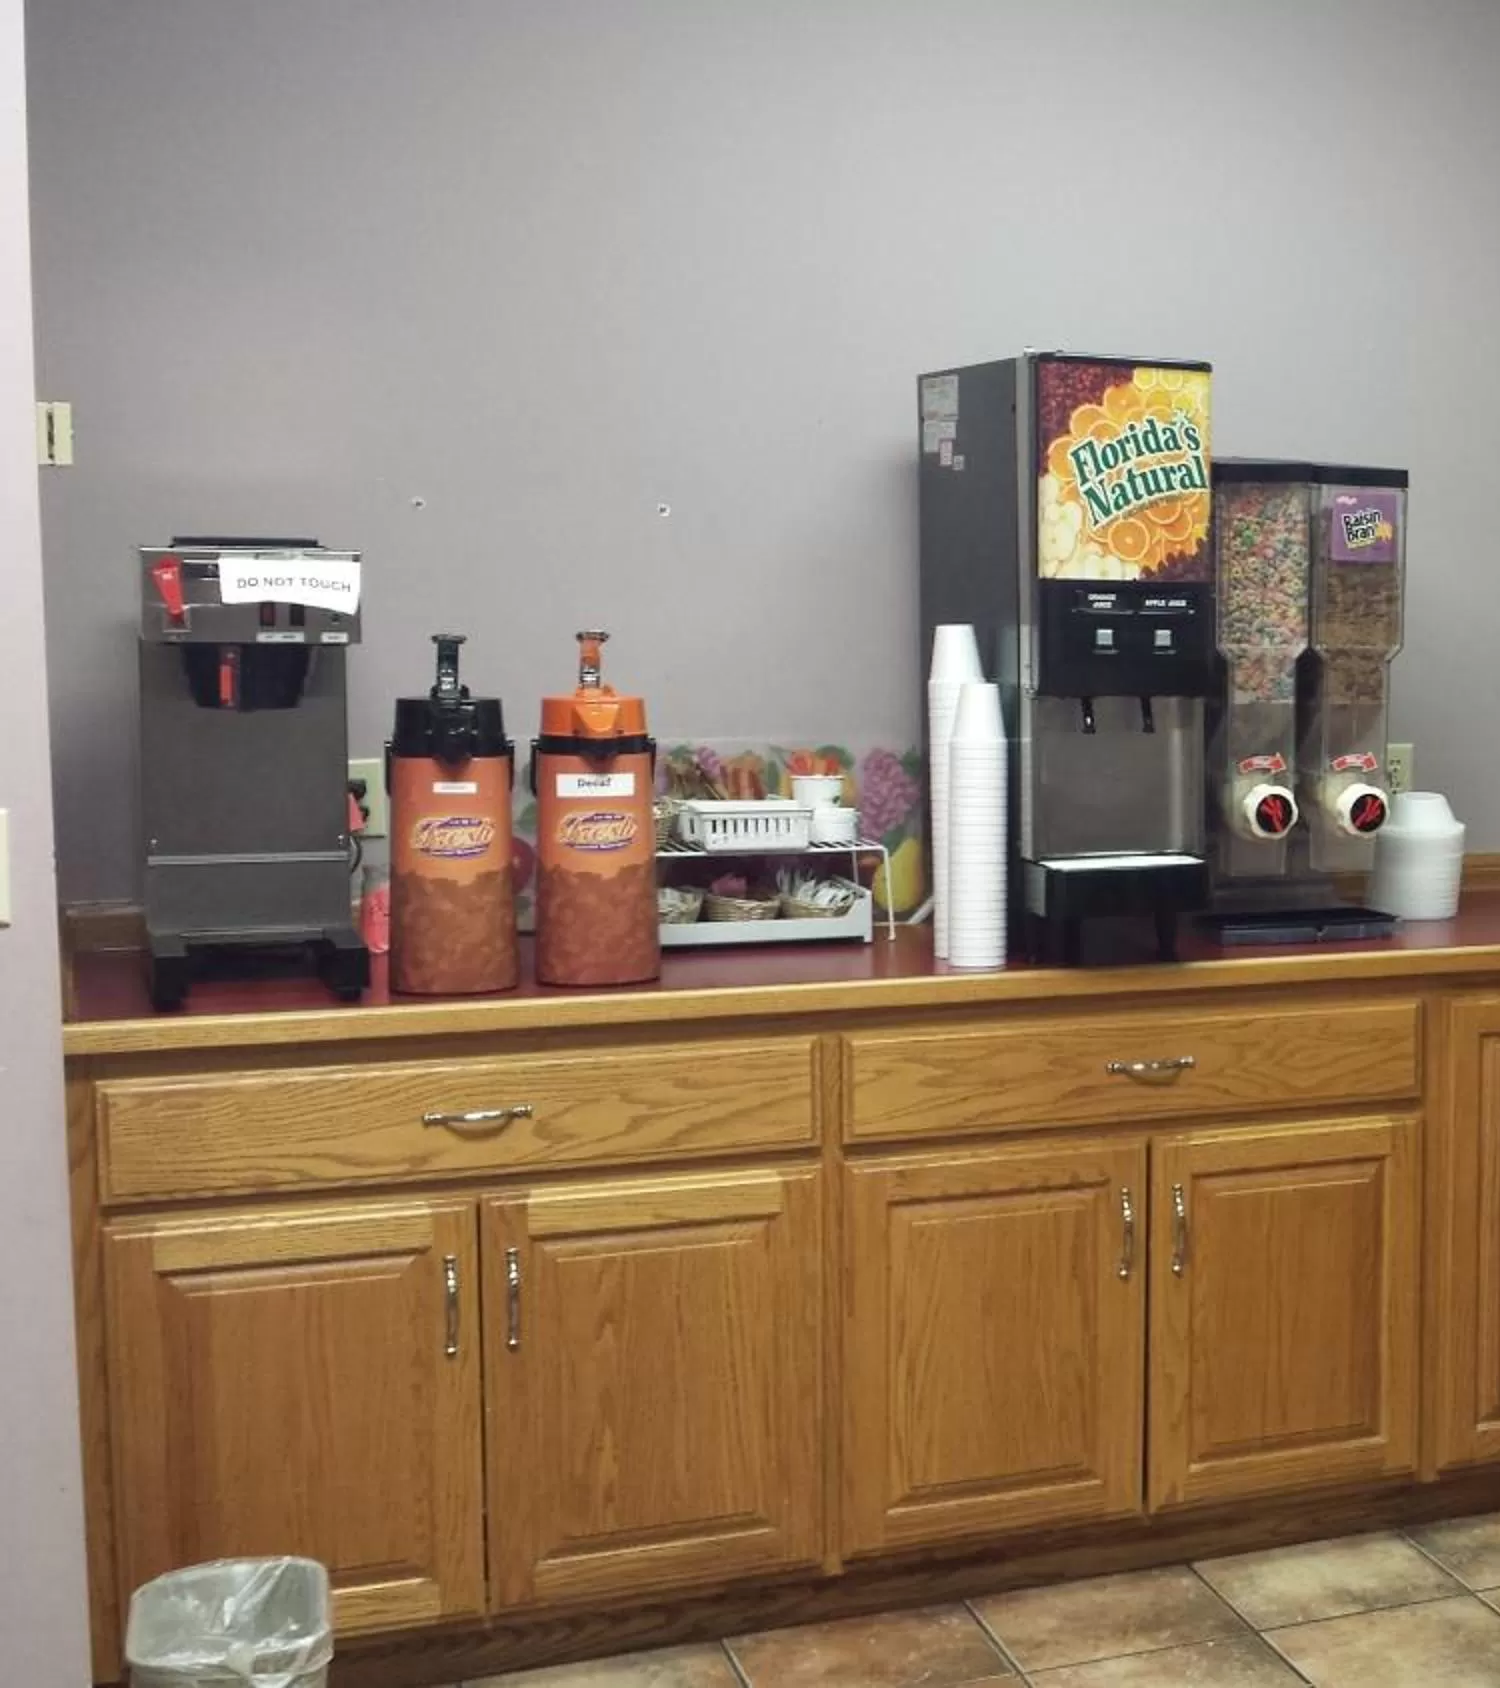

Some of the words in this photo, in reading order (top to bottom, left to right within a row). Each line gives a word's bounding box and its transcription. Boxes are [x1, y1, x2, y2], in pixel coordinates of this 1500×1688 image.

[1070, 418, 1201, 486] Florida's
[1083, 456, 1207, 525] Natural
[1342, 509, 1382, 529] Raisin
[1346, 526, 1376, 542] Bran
[236, 577, 259, 590] DO
[264, 577, 294, 588] NOT
[299, 577, 352, 593] TOUCH
[577, 777, 612, 789] Decaf
